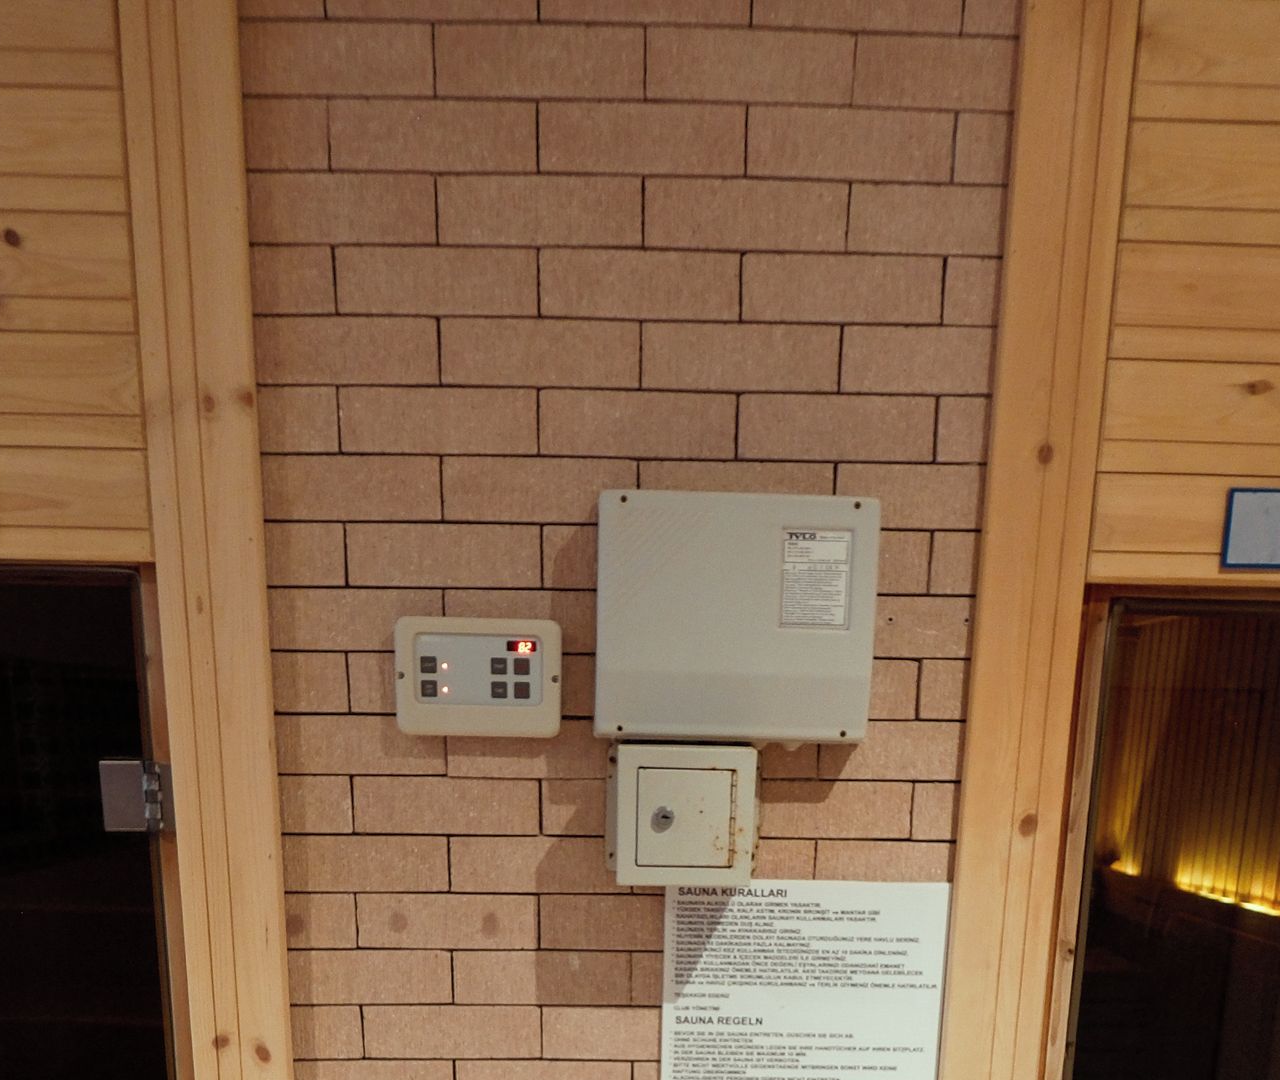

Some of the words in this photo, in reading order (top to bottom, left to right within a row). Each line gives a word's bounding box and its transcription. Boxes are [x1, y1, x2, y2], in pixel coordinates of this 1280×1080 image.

[517, 642, 532, 653] 82
[678, 887, 718, 897] SAUNA
[721, 888, 788, 898] KURALLARI
[675, 1016, 714, 1025] SAUNA
[717, 1016, 763, 1026] REGELN
